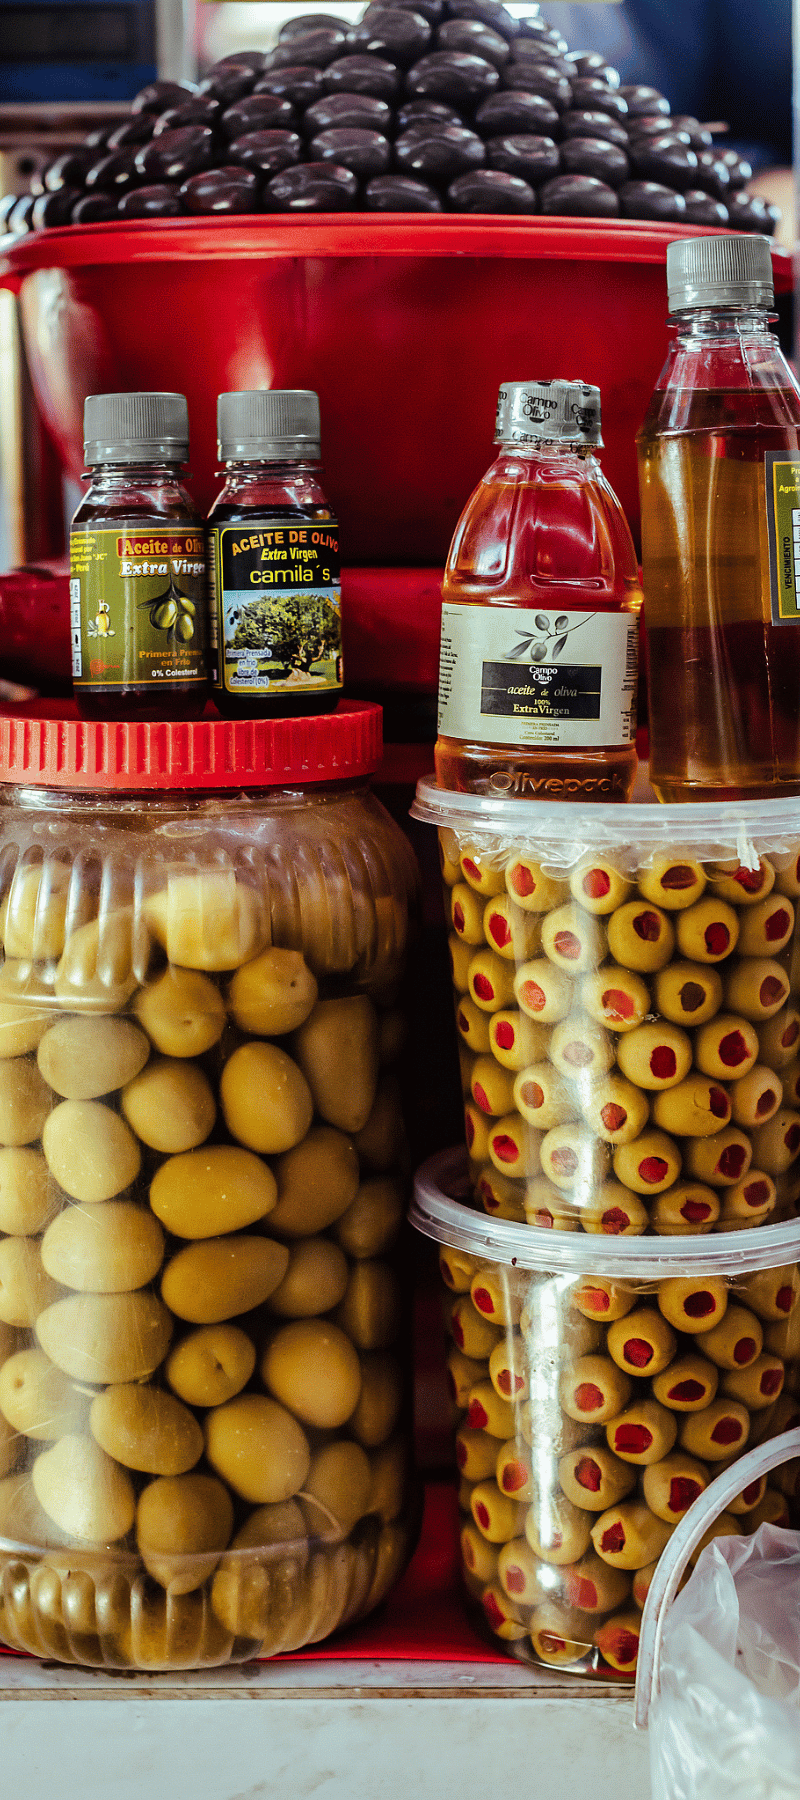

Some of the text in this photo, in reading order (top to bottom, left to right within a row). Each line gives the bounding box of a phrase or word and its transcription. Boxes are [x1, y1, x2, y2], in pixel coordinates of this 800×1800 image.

[520, 393, 557, 409] Campo
[523, 404, 550, 419] Olivo
[123, 539, 168, 555] Aceite
[172, 543, 182, 553] de
[232, 531, 284, 556] ACEITE
[289, 530, 307, 544] DE
[261, 547, 318, 562] Extra Virgen
[121, 561, 168, 576] Extra
[783, 536, 792, 589] VENCIMIENTO
[139, 650, 177, 658] Primera
[246, 648, 271, 657] Prensada
[165, 668, 198, 677] Colesterol
[529, 666, 558, 675] Campo
[533, 673, 552, 681] Olivo
[507, 685, 577, 697] aceite de oliva
